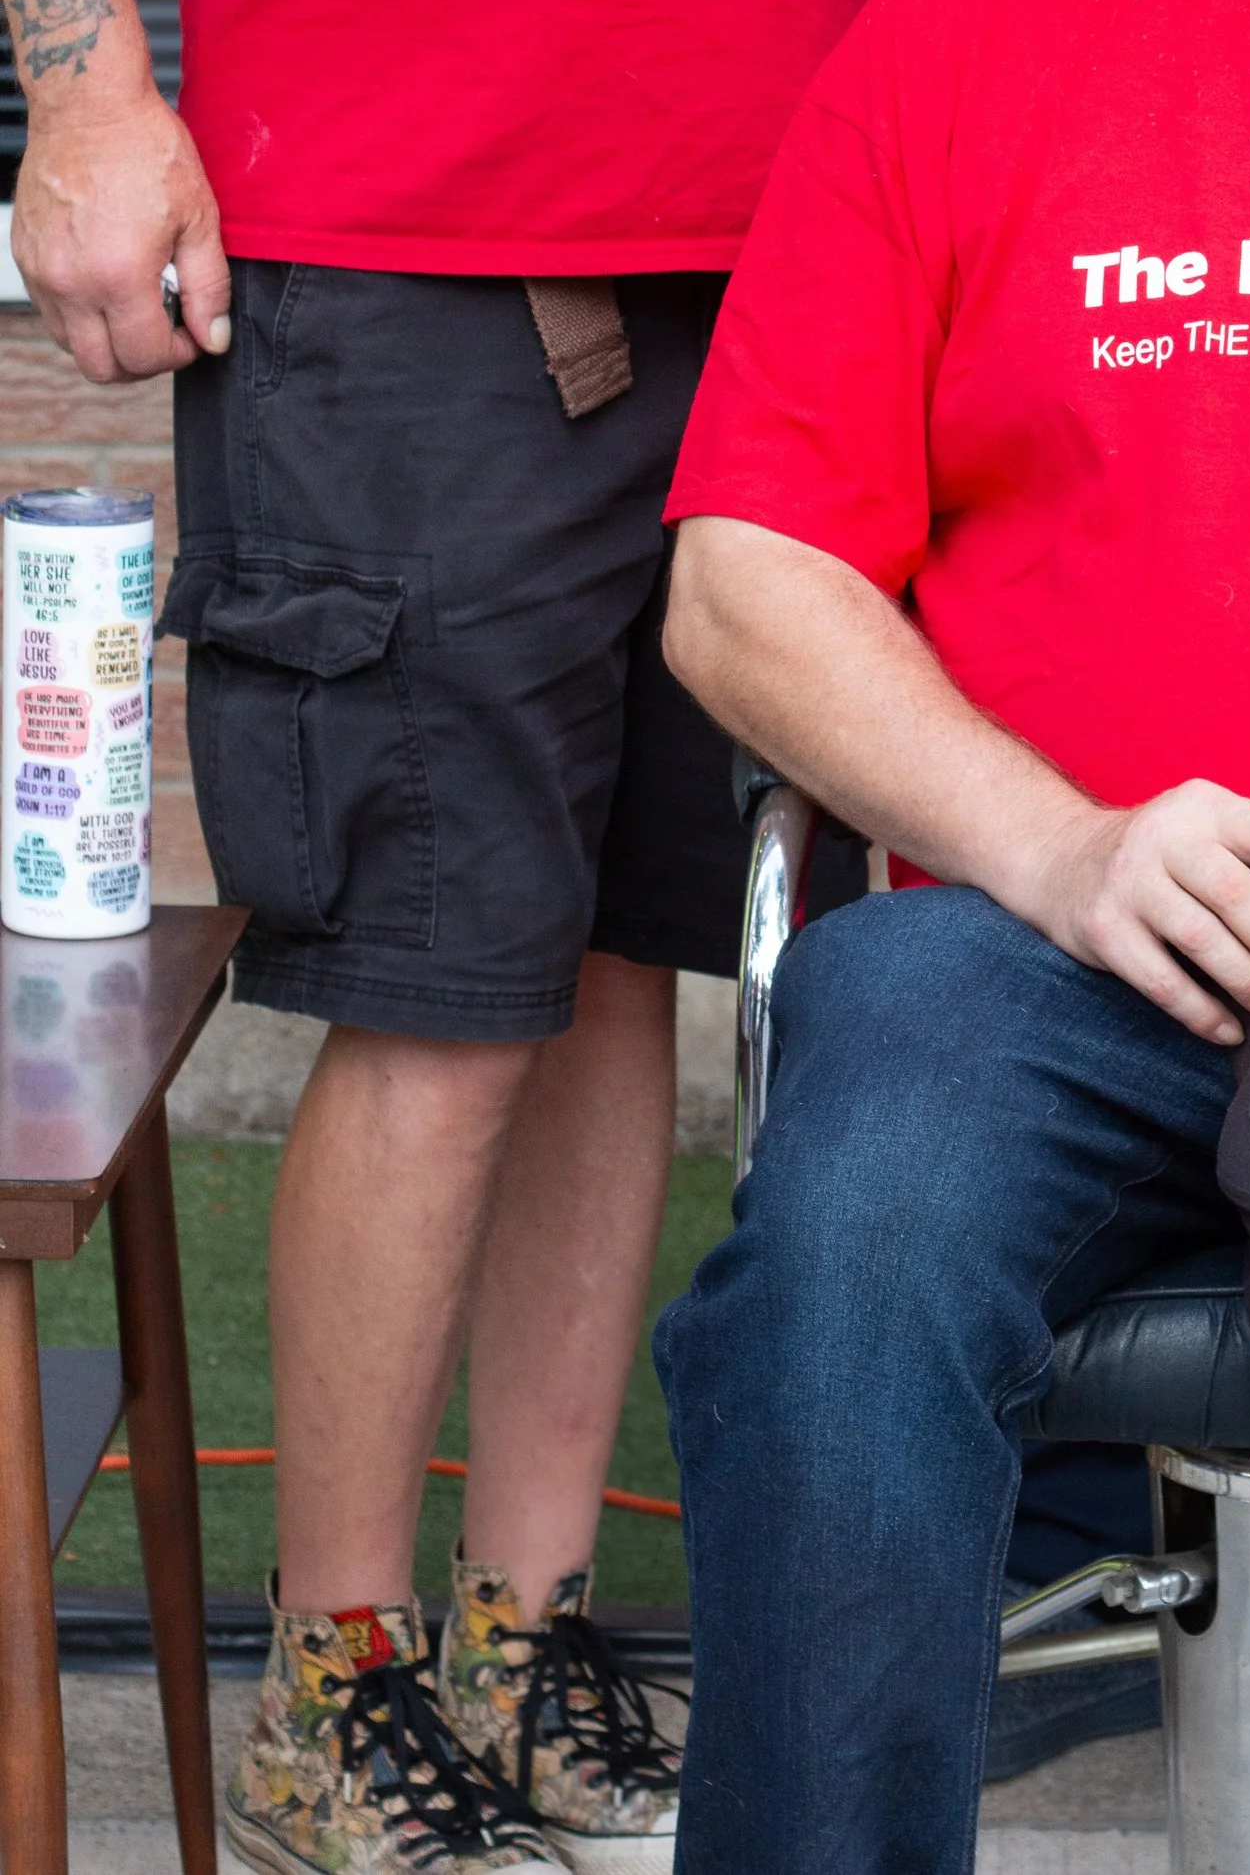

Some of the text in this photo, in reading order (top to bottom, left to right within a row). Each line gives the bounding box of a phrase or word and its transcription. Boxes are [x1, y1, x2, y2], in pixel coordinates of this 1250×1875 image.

[1072, 244, 1209, 309] The
[1092, 335, 1174, 370] Keep
[1183, 320, 1250, 356] THE
[44, 553, 75, 564] WITHIN
[121, 553, 139, 570] THE
[21, 563, 72, 581] HER SHE
[23, 581, 67, 594] WILL NOT
[122, 575, 134, 588] OF
[24, 629, 52, 646] LOVE
[25, 646, 51, 663] LIKE
[20, 663, 57, 681] JESUS
[96, 660, 138, 676] RENEWED
[24, 703, 82, 717] EVERYTHING
[109, 702, 128, 718] YOU
[75, 720, 86, 731] IN
[24, 763, 65, 784] I AM A
[41, 785, 52, 796] OF
[59, 787, 81, 800] GOD
[80, 812, 134, 827] WITH GOD
